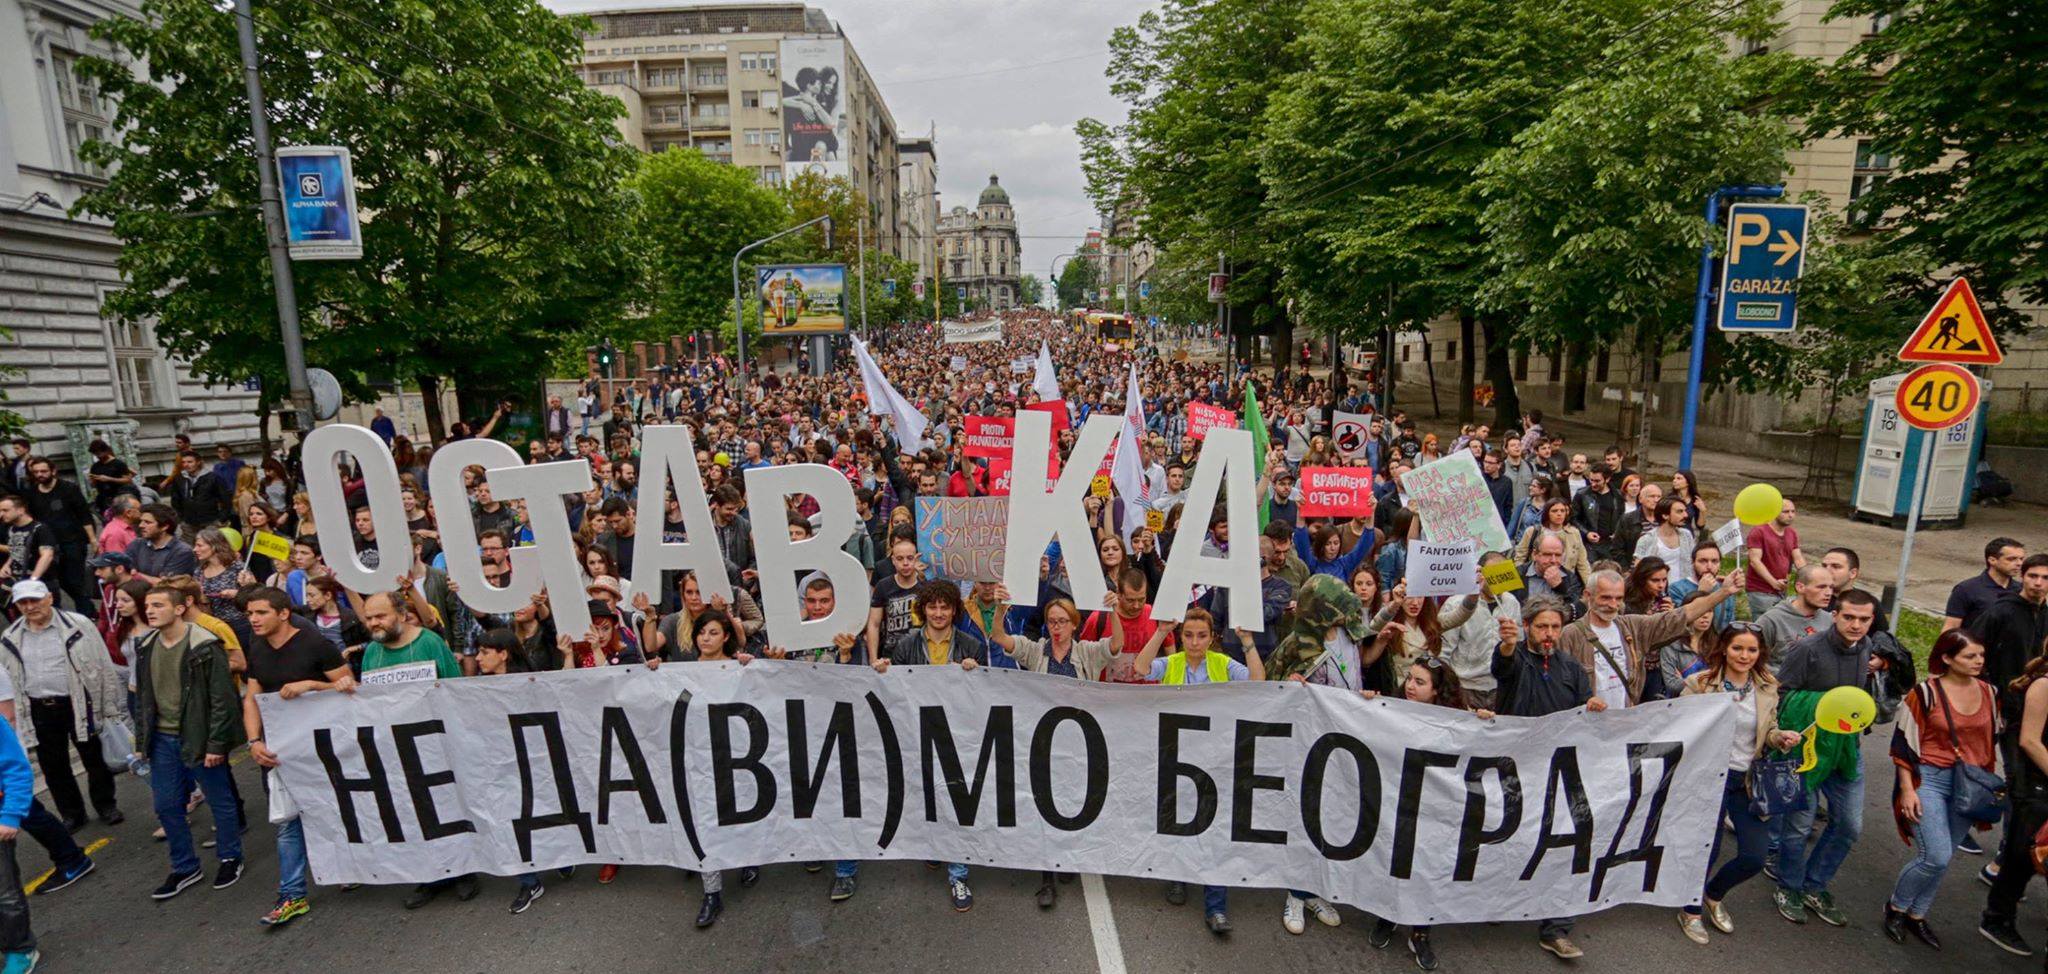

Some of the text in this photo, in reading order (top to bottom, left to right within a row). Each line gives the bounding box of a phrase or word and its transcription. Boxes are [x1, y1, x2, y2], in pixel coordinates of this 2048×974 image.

[314, 200, 339, 208] BANK
[1730, 214, 1771, 265] P
[1728, 277, 1792, 294] GARAŽA
[1910, 381, 1961, 412] 40
[981, 423, 1006, 436] PROTIV
[1947, 432, 1966, 442] TOI
[1312, 473, 1369, 489] ВРАТИЋЕМО
[1309, 491, 1350, 506] ОТЕТО
[1420, 546, 1472, 557] FANTOMKA
[1429, 563, 1463, 571] GLAVU
[1430, 576, 1457, 586] ČUVA
[313, 688, 1684, 902] НЕ ДА(ВИ)МО БЕОГРАД
